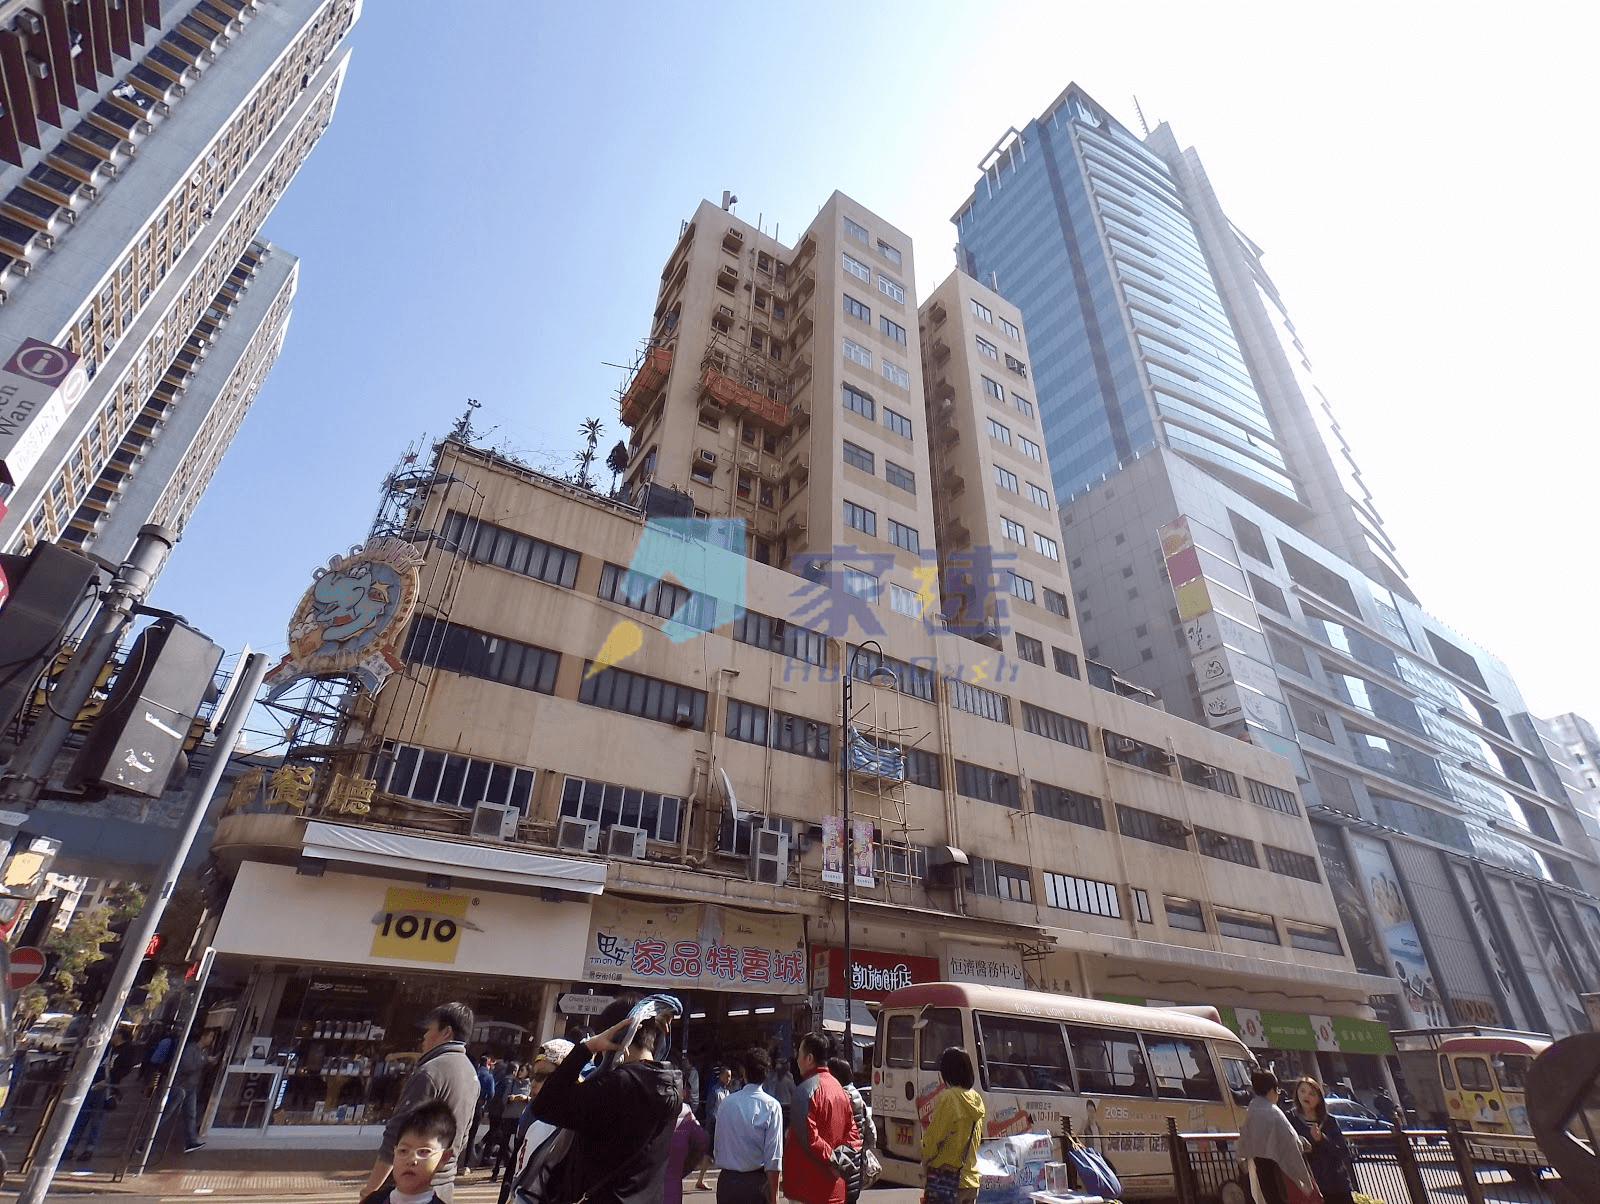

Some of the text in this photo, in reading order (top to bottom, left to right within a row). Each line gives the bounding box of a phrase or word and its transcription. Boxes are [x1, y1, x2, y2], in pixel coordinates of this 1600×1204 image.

[0, 385, 19, 413] en
[0, 400, 36, 436] Wan
[381, 912, 457, 943] 1010
[631, 936, 805, 984] 家品特賣城
[950, 957, 1022, 980] 恒濟醫務中心
[850, 961, 912, 992] 凱施餅店
[1014, 1003, 1041, 1015] PUBLIC
[1045, 1008, 1067, 1018] LIGHT
[1104, 1106, 1129, 1119] 2036
